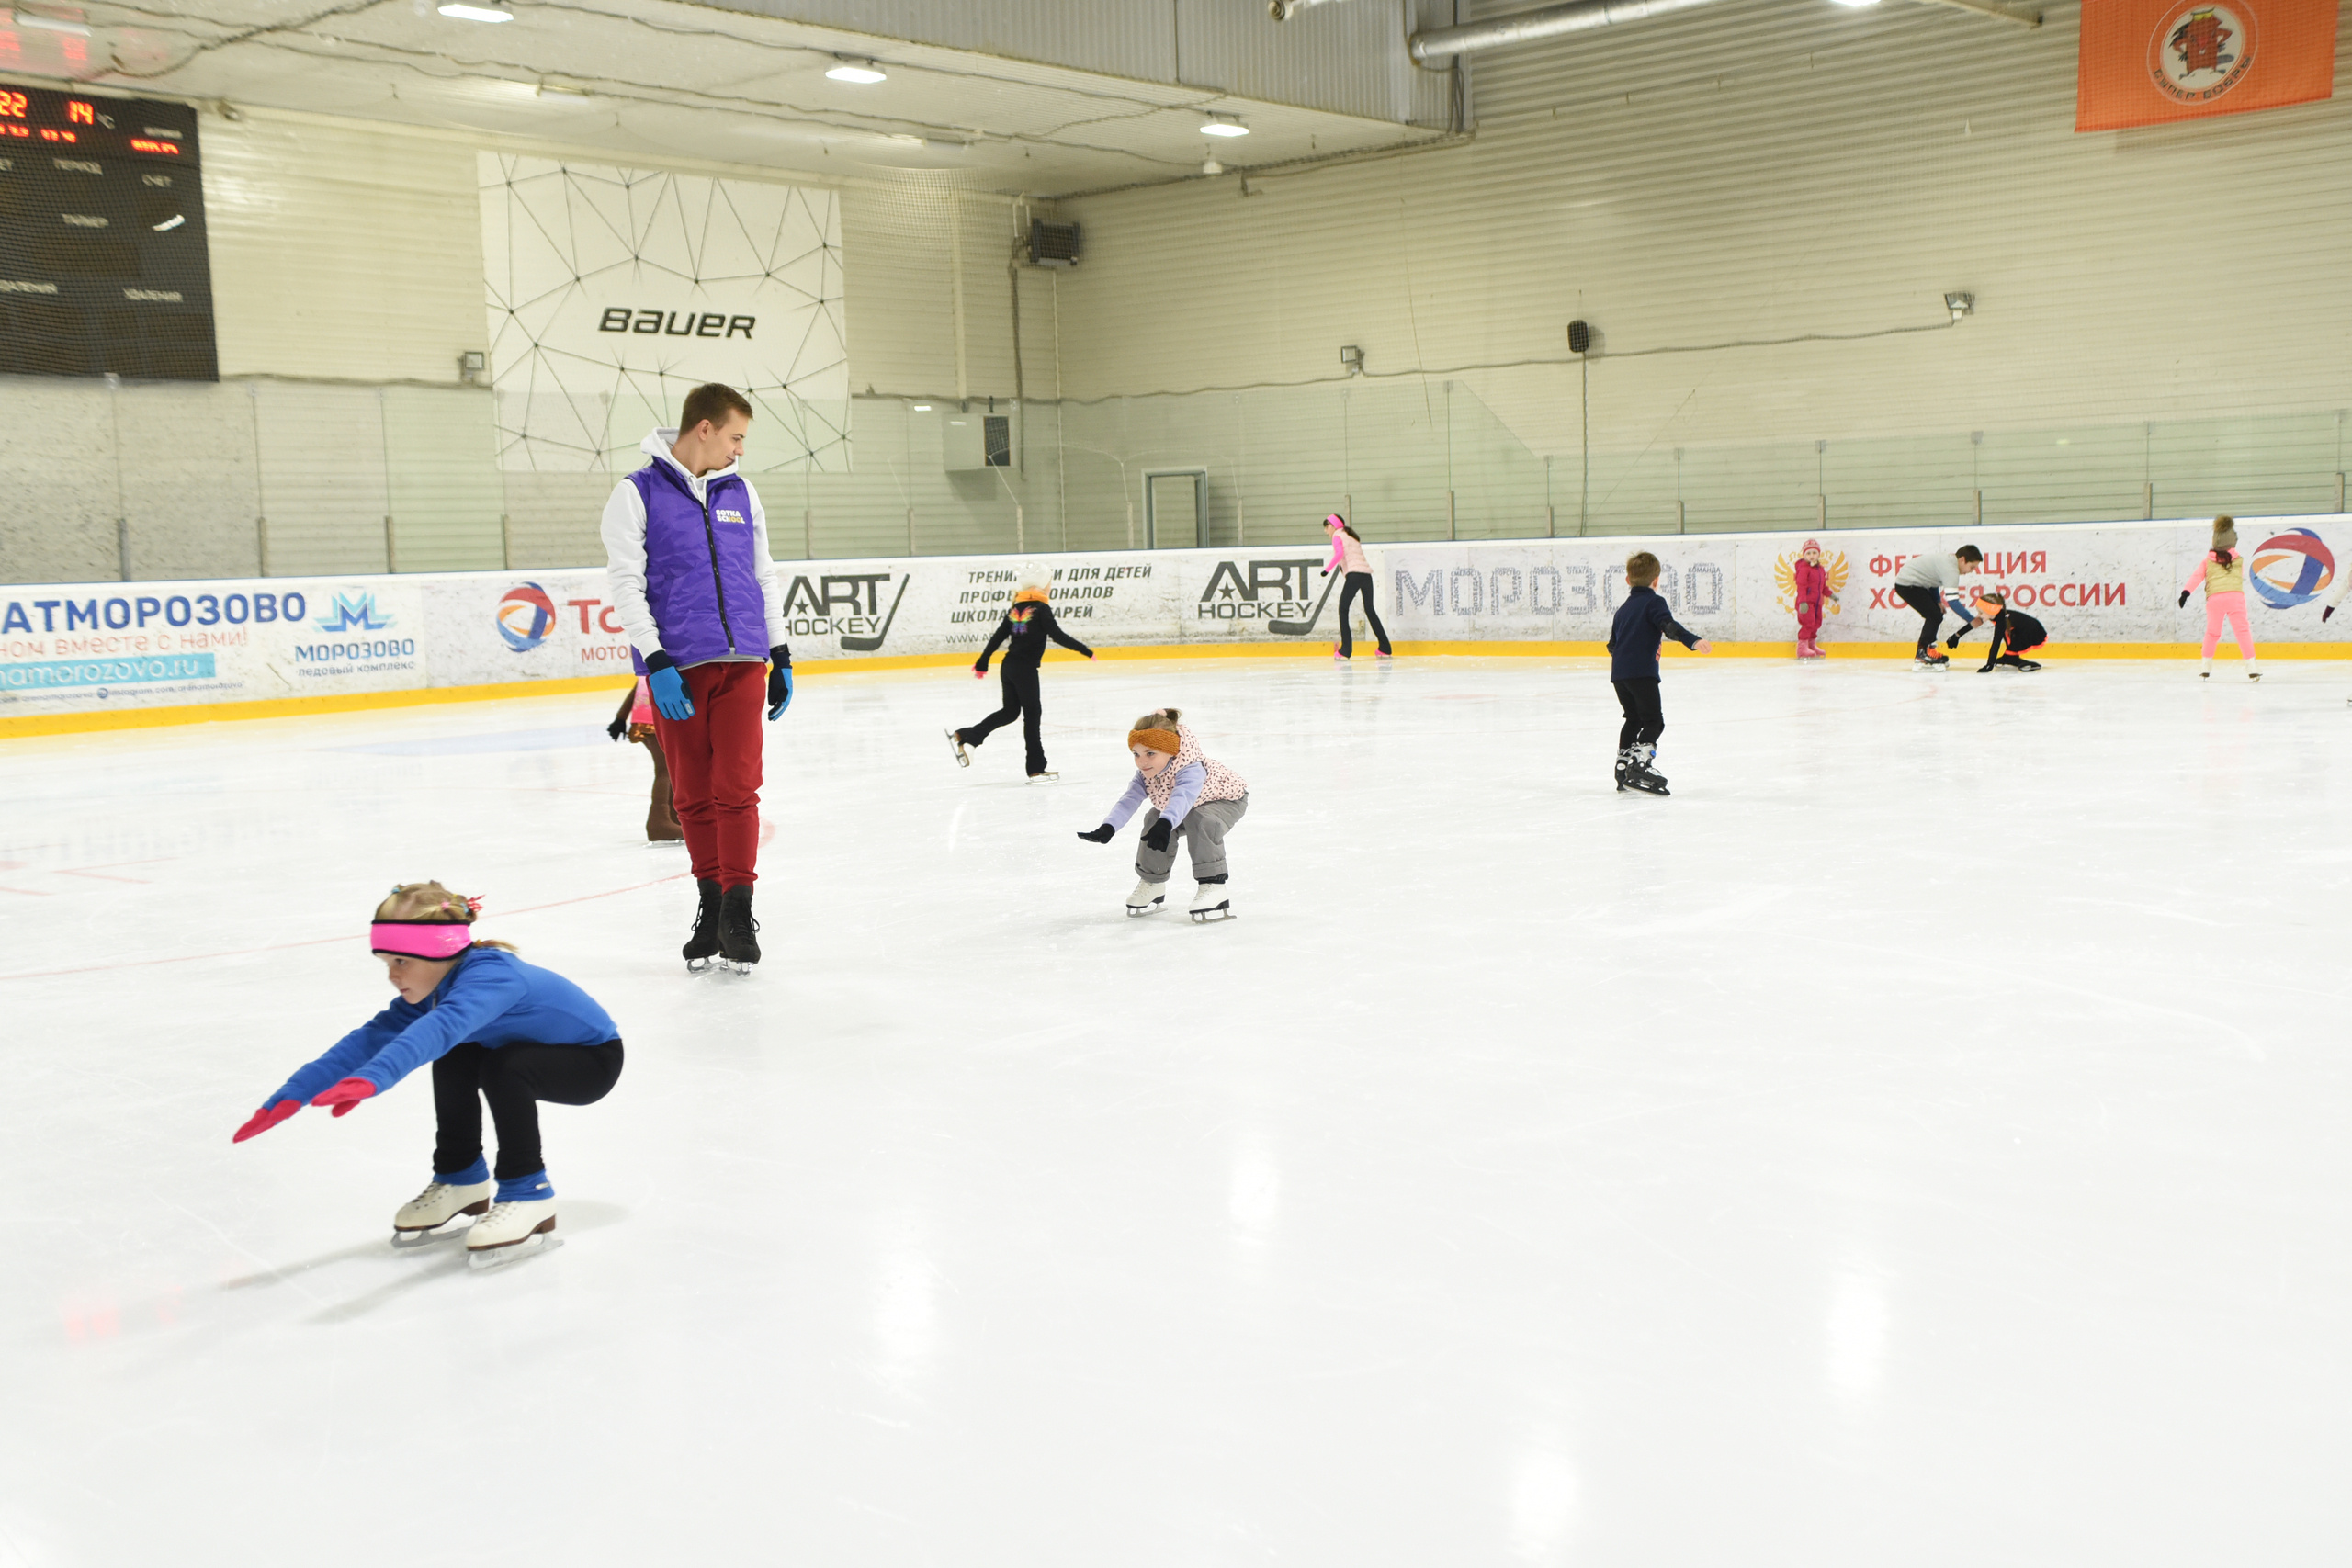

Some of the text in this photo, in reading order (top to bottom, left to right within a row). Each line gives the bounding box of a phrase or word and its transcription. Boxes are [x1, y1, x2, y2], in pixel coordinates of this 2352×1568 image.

[2154, 56, 2251, 100] СУПЕР БОБРЫ
[1067, 567, 1101, 582] ДЛЯ
[1104, 565, 1152, 581] ДЕТЕЙ
[1200, 558, 1324, 603] ART
[783, 573, 890, 617] ART
[1996, 582, 2126, 608] РОССИИ
[951, 608, 1008, 624] ШКОЛА
[1198, 602, 1314, 619] HOCKEY
[55, 634, 148, 655] вместе
[180, 626, 248, 649] нами!
[295, 638, 414, 662] МОРОЗОВО
[581, 645, 632, 662] МОТО
[298, 661, 414, 677] ледовый комплекс
